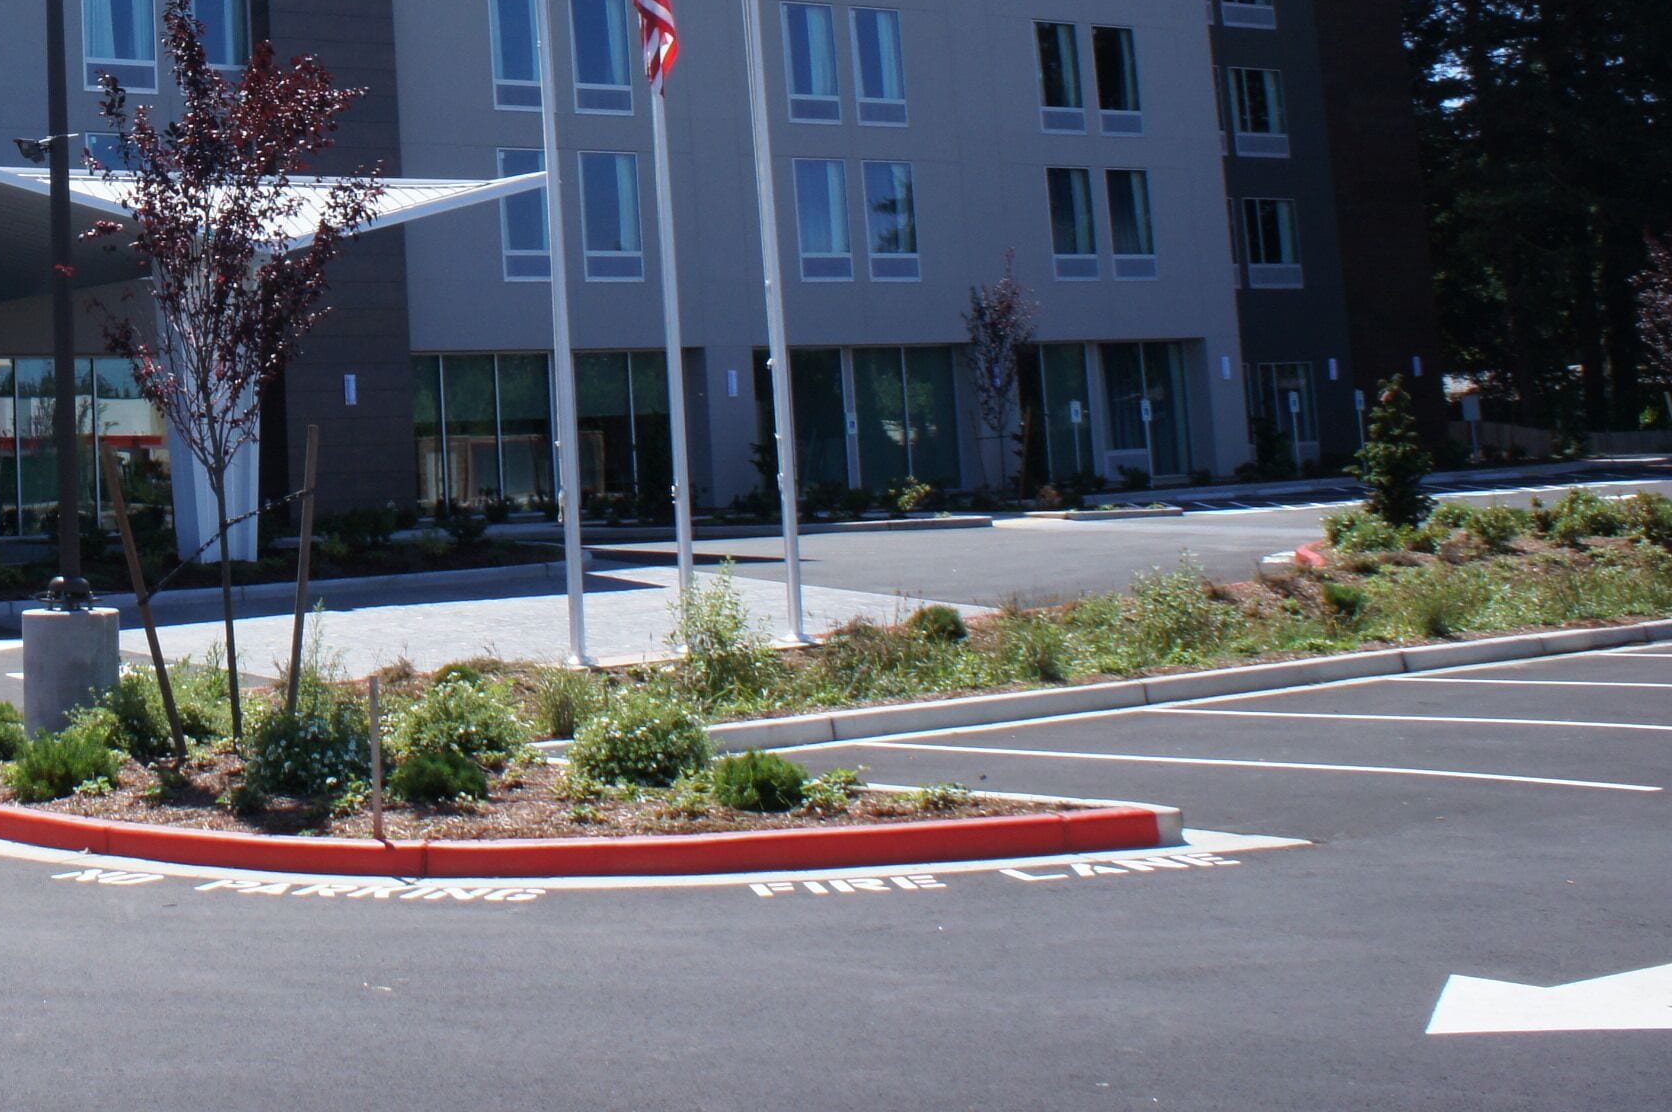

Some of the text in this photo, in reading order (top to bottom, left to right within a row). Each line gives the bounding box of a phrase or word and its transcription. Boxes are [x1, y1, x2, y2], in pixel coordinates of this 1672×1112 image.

[51, 868, 547, 902] NO PARKING
[748, 852, 1242, 897] FIRE LANE
